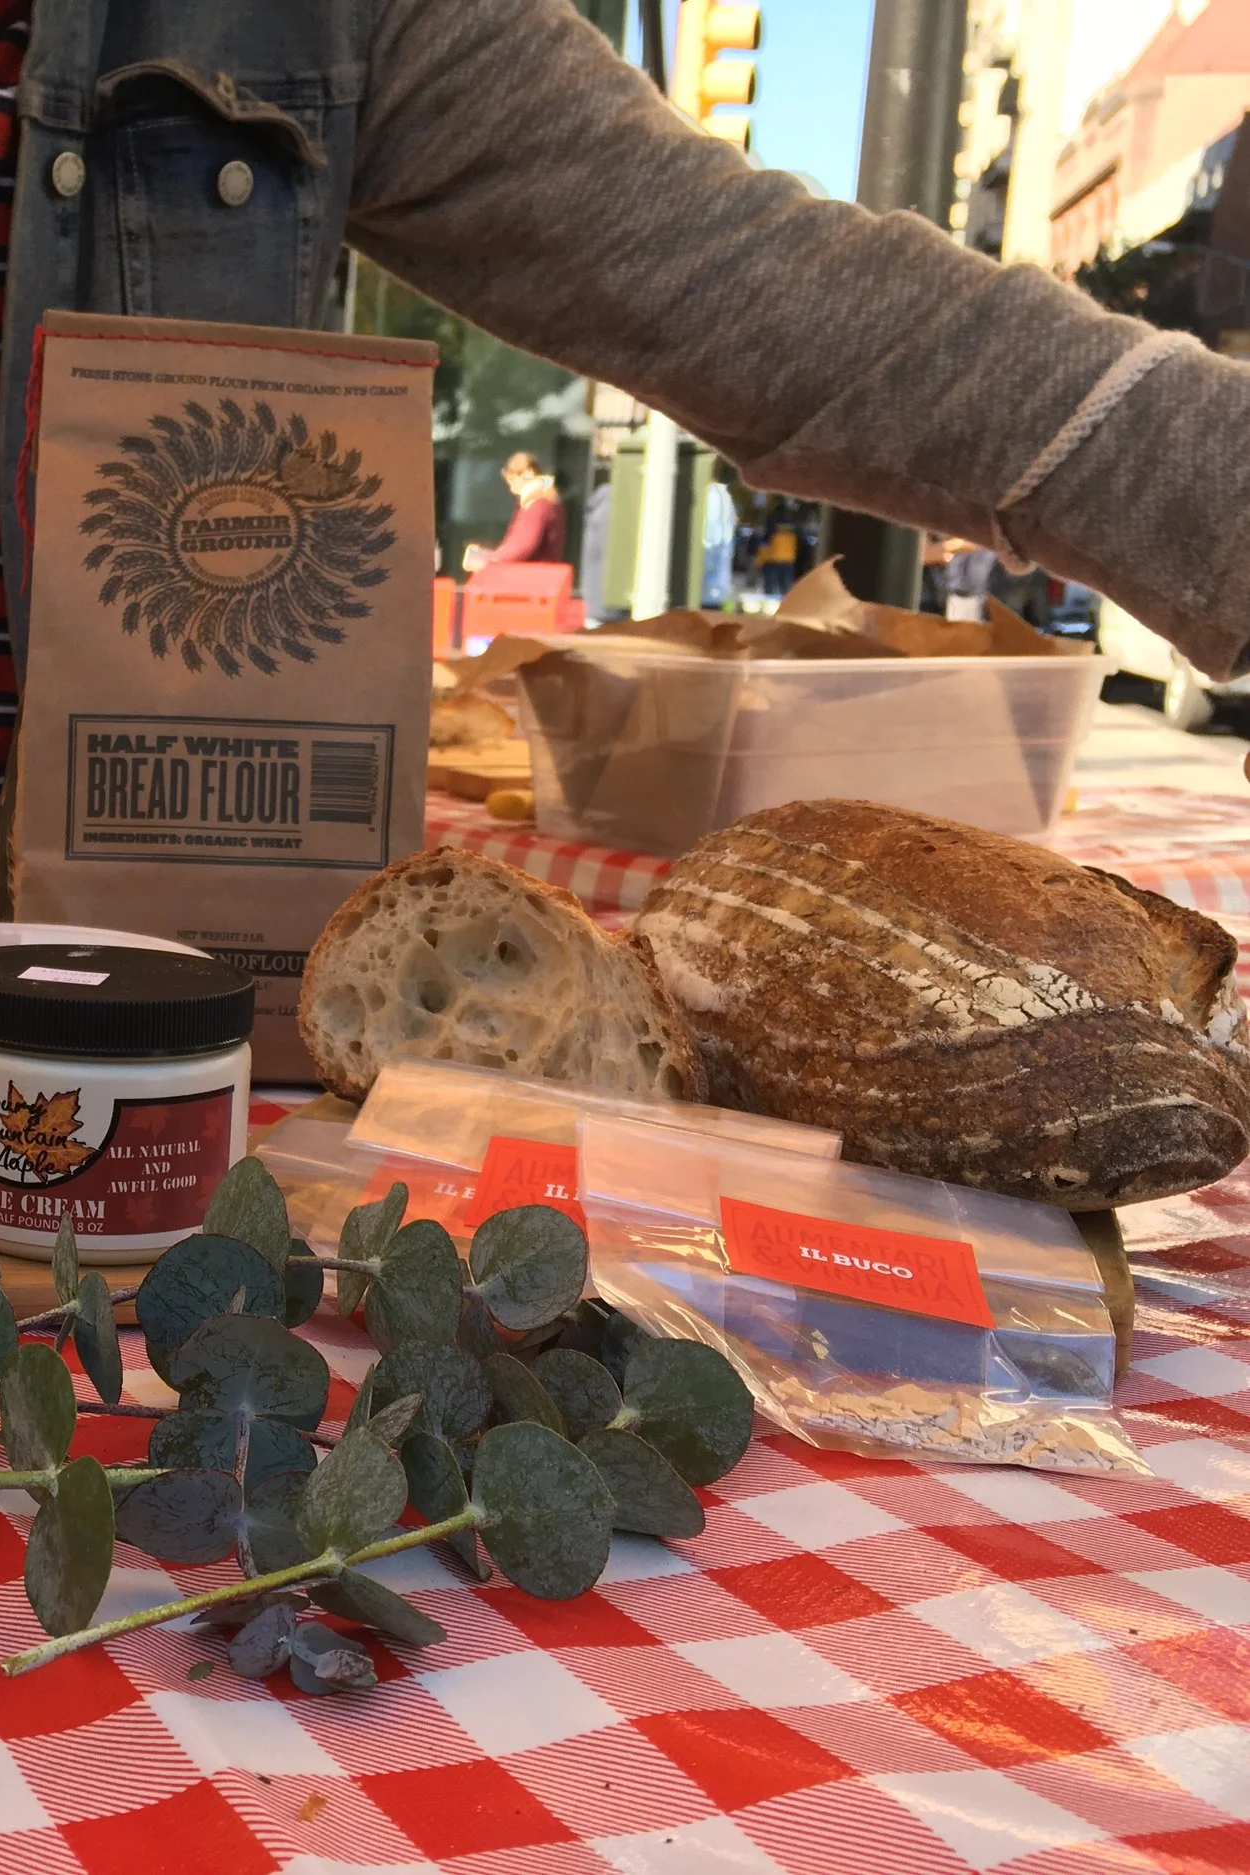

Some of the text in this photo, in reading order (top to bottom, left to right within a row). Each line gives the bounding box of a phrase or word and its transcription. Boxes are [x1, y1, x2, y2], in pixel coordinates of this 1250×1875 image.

[181, 515, 290, 533] FARMER
[180, 535, 291, 552] GROUND
[87, 734, 299, 758] HALF WHITE
[86, 757, 189, 820] BREAD
[200, 760, 301, 824] FLOUR
[83, 832, 302, 849] INGREDIENTS: ORGANIC WHEAT
[106, 1140, 200, 1158] ALL NATURAL
[141, 1161, 171, 1175] AND
[107, 1175, 197, 1193] AWFUL GOOD
[433, 1182, 459, 1197] IL
[543, 1183, 569, 1200] IL
[21, 1194, 106, 1219] CREAM
[18, 1215, 60, 1230] POUND
[77, 1222, 84, 1232] 8
[88, 1222, 104, 1233] OZ
[798, 1246, 914, 1280] IL BUCO
